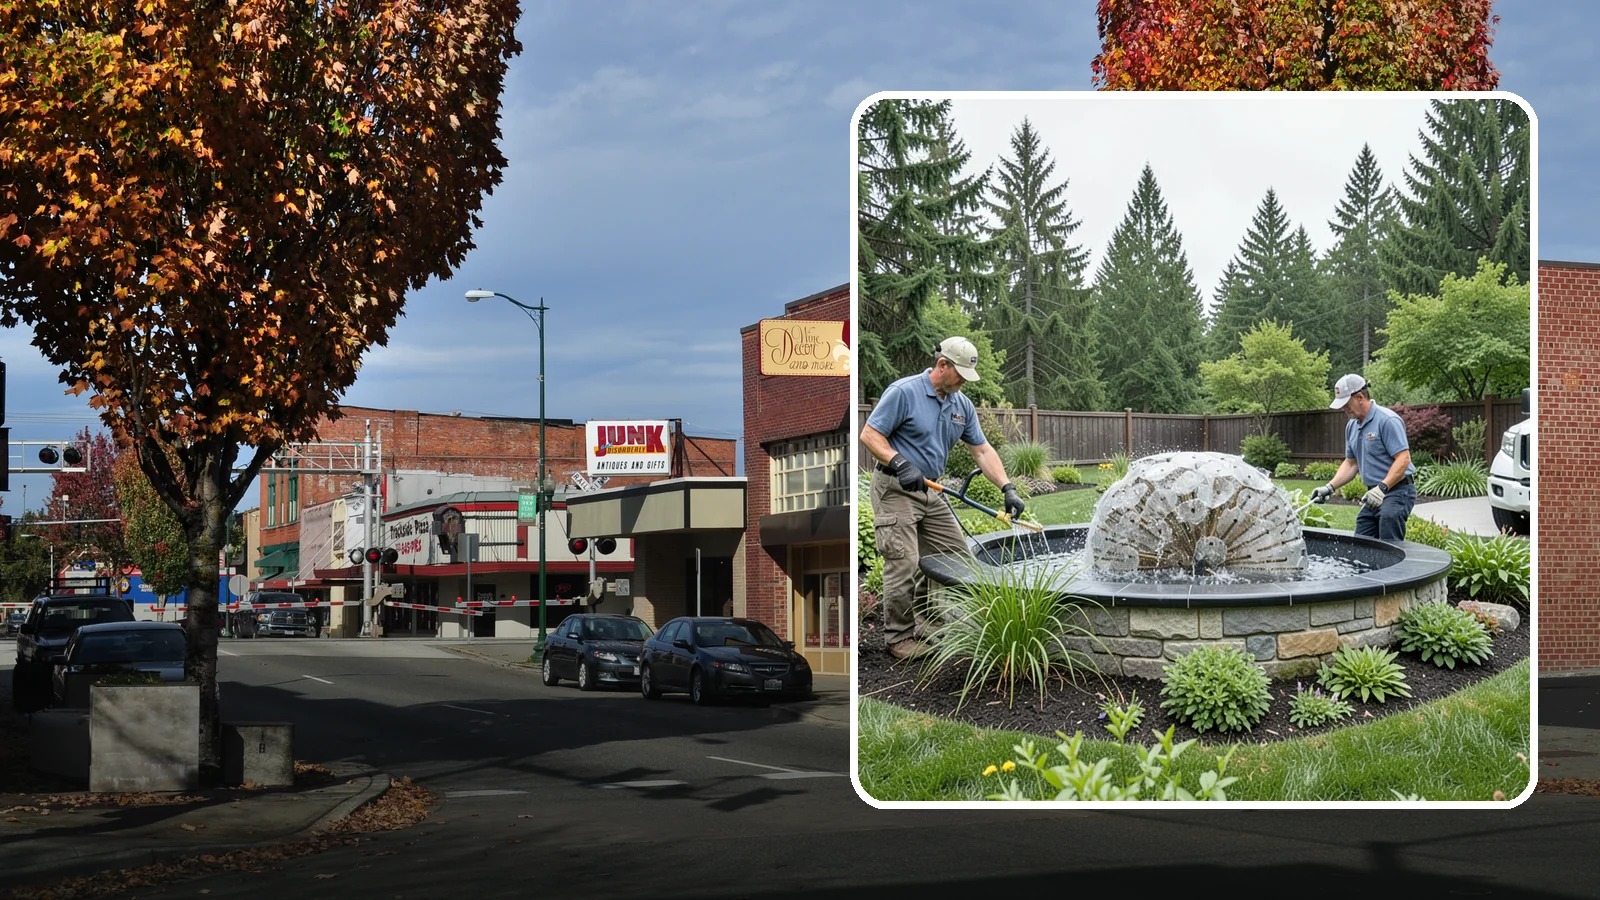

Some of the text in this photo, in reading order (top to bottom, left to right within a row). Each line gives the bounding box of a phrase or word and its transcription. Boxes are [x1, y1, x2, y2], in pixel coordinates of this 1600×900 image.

[595, 426, 663, 456] JUNK
[607, 446, 646, 454] DISORDERLY
[597, 461, 665, 470] ANTIQUES AND GIFTS
[390, 520, 429, 540] Trackside Pizza
